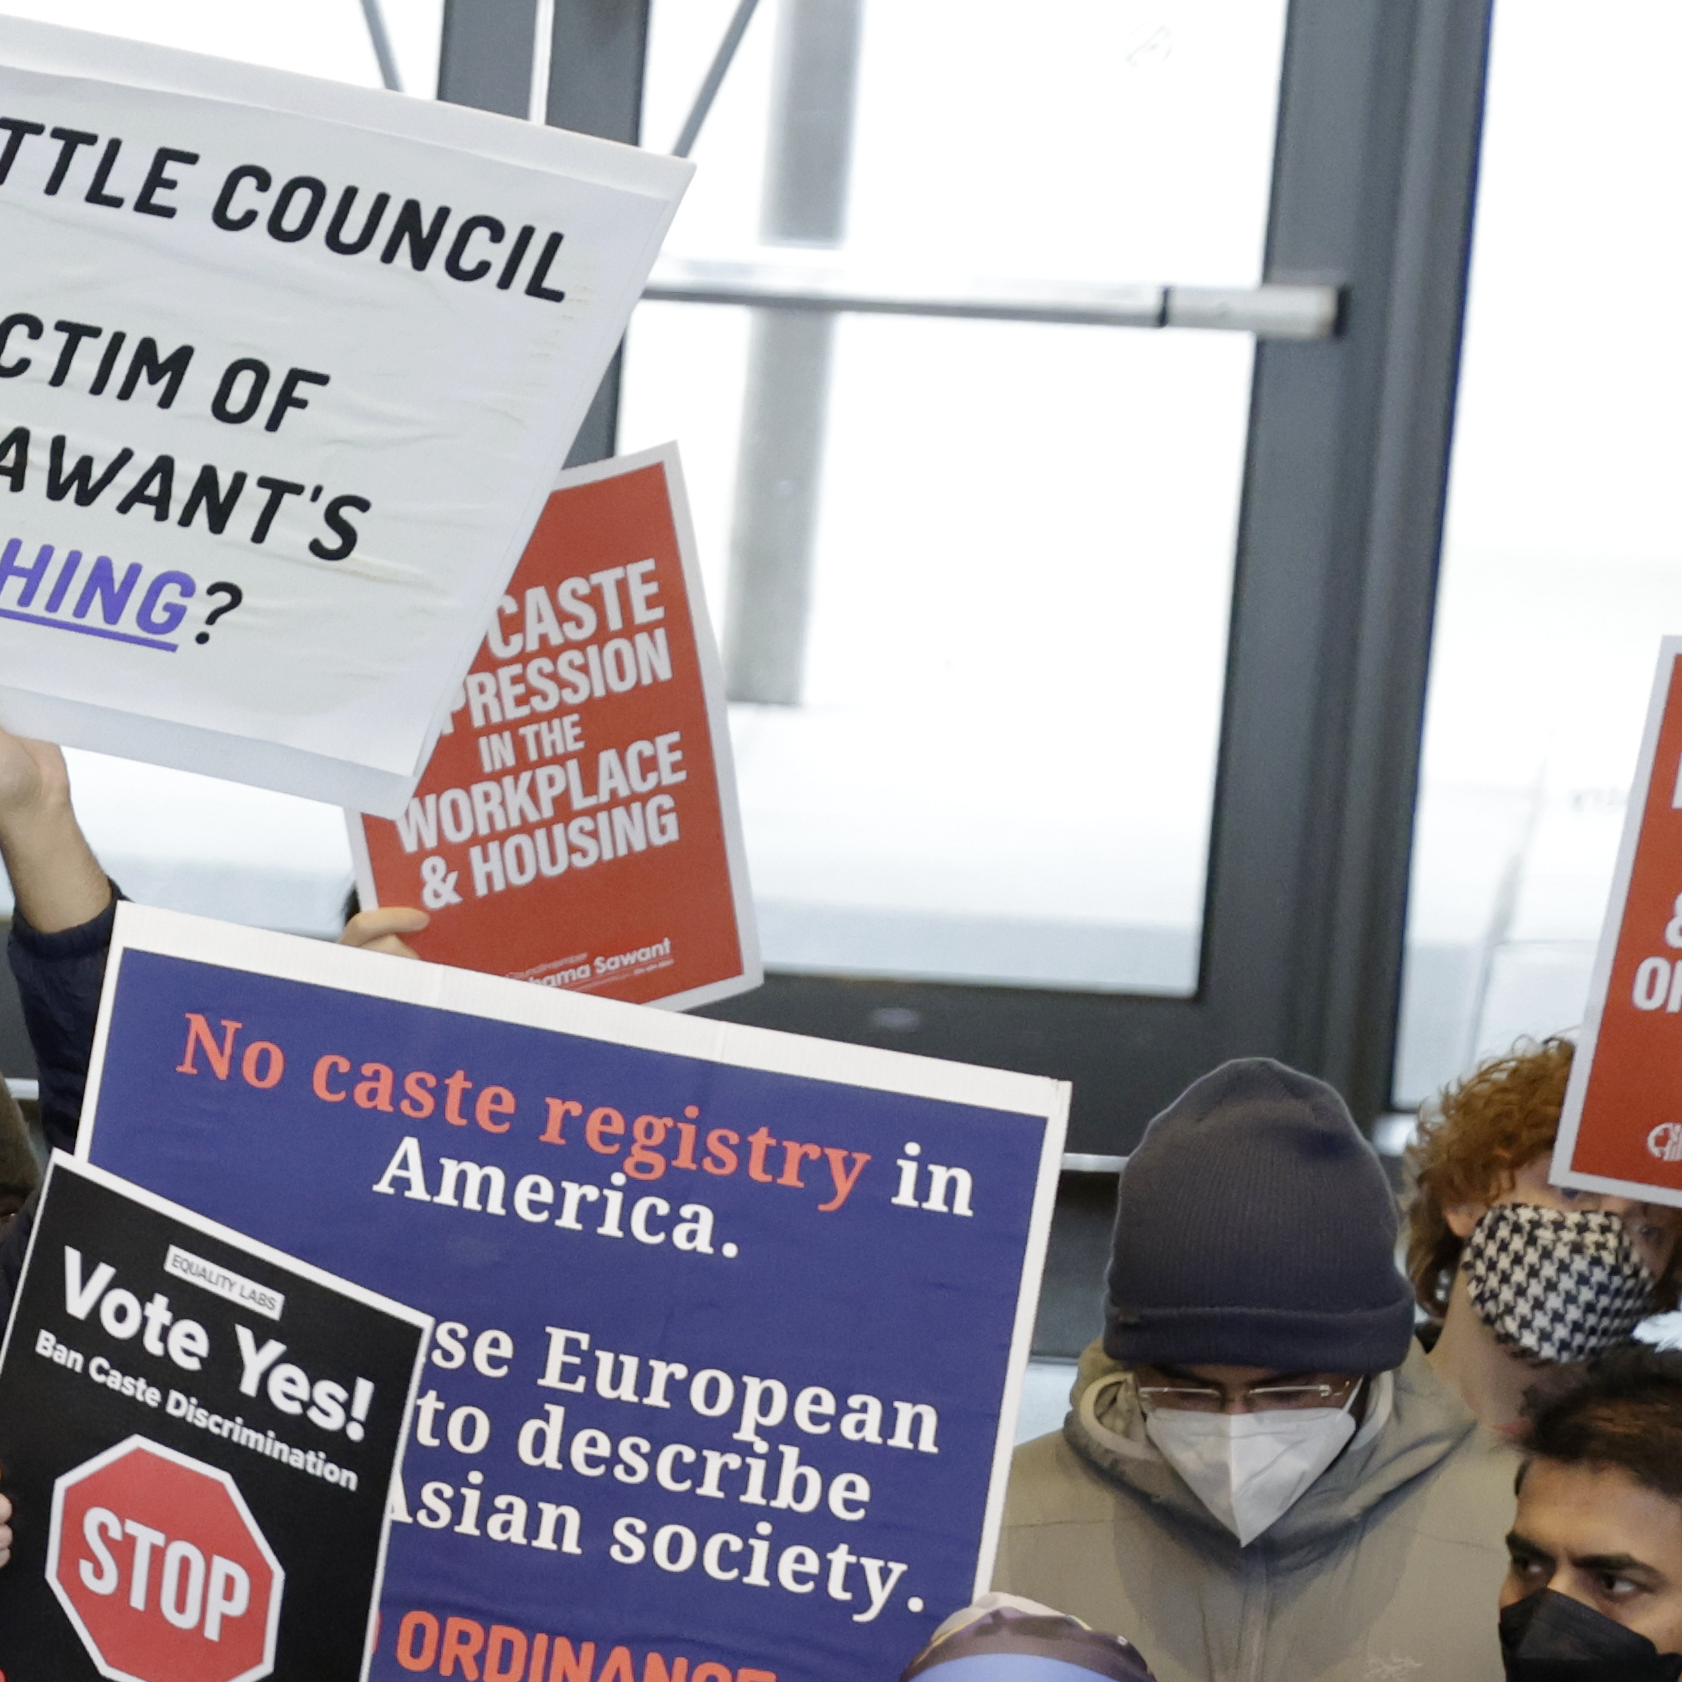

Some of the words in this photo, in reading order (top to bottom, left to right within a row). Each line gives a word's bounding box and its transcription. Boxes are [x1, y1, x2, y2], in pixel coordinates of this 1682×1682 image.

[211, 164, 569, 303] COUNCIL
[211, 357, 331, 435] OF
[486, 558, 665, 660] CASTE
[395, 731, 686, 854] WORKPLACE
[477, 731, 516, 773] IN
[518, 713, 585, 762] THE
[421, 855, 463, 909] &
[469, 794, 679, 897] HOUSING
[593, 937, 672, 974] Sawant
[175, 1013, 286, 1089] No
[309, 1052, 519, 1136] caste
[543, 1095, 872, 1212] registry
[891, 1142, 976, 1217] in
[372, 1136, 742, 1259] America.
[63, 1245, 210, 1371] Vote
[235, 1322, 376, 1443] Yes!
[171, 1253, 238, 1296] EQUALITY
[239, 1283, 278, 1315] LABS
[35, 1328, 84, 1375] Ban
[88, 1357, 161, 1407] Caste
[167, 1388, 358, 1493] Discrimination
[536, 1326, 941, 1454] European
[416, 1389, 490, 1454] to
[516, 1407, 871, 1522] describe
[78, 1504, 251, 1643] STOP
[610, 1511, 926, 1623] society.
